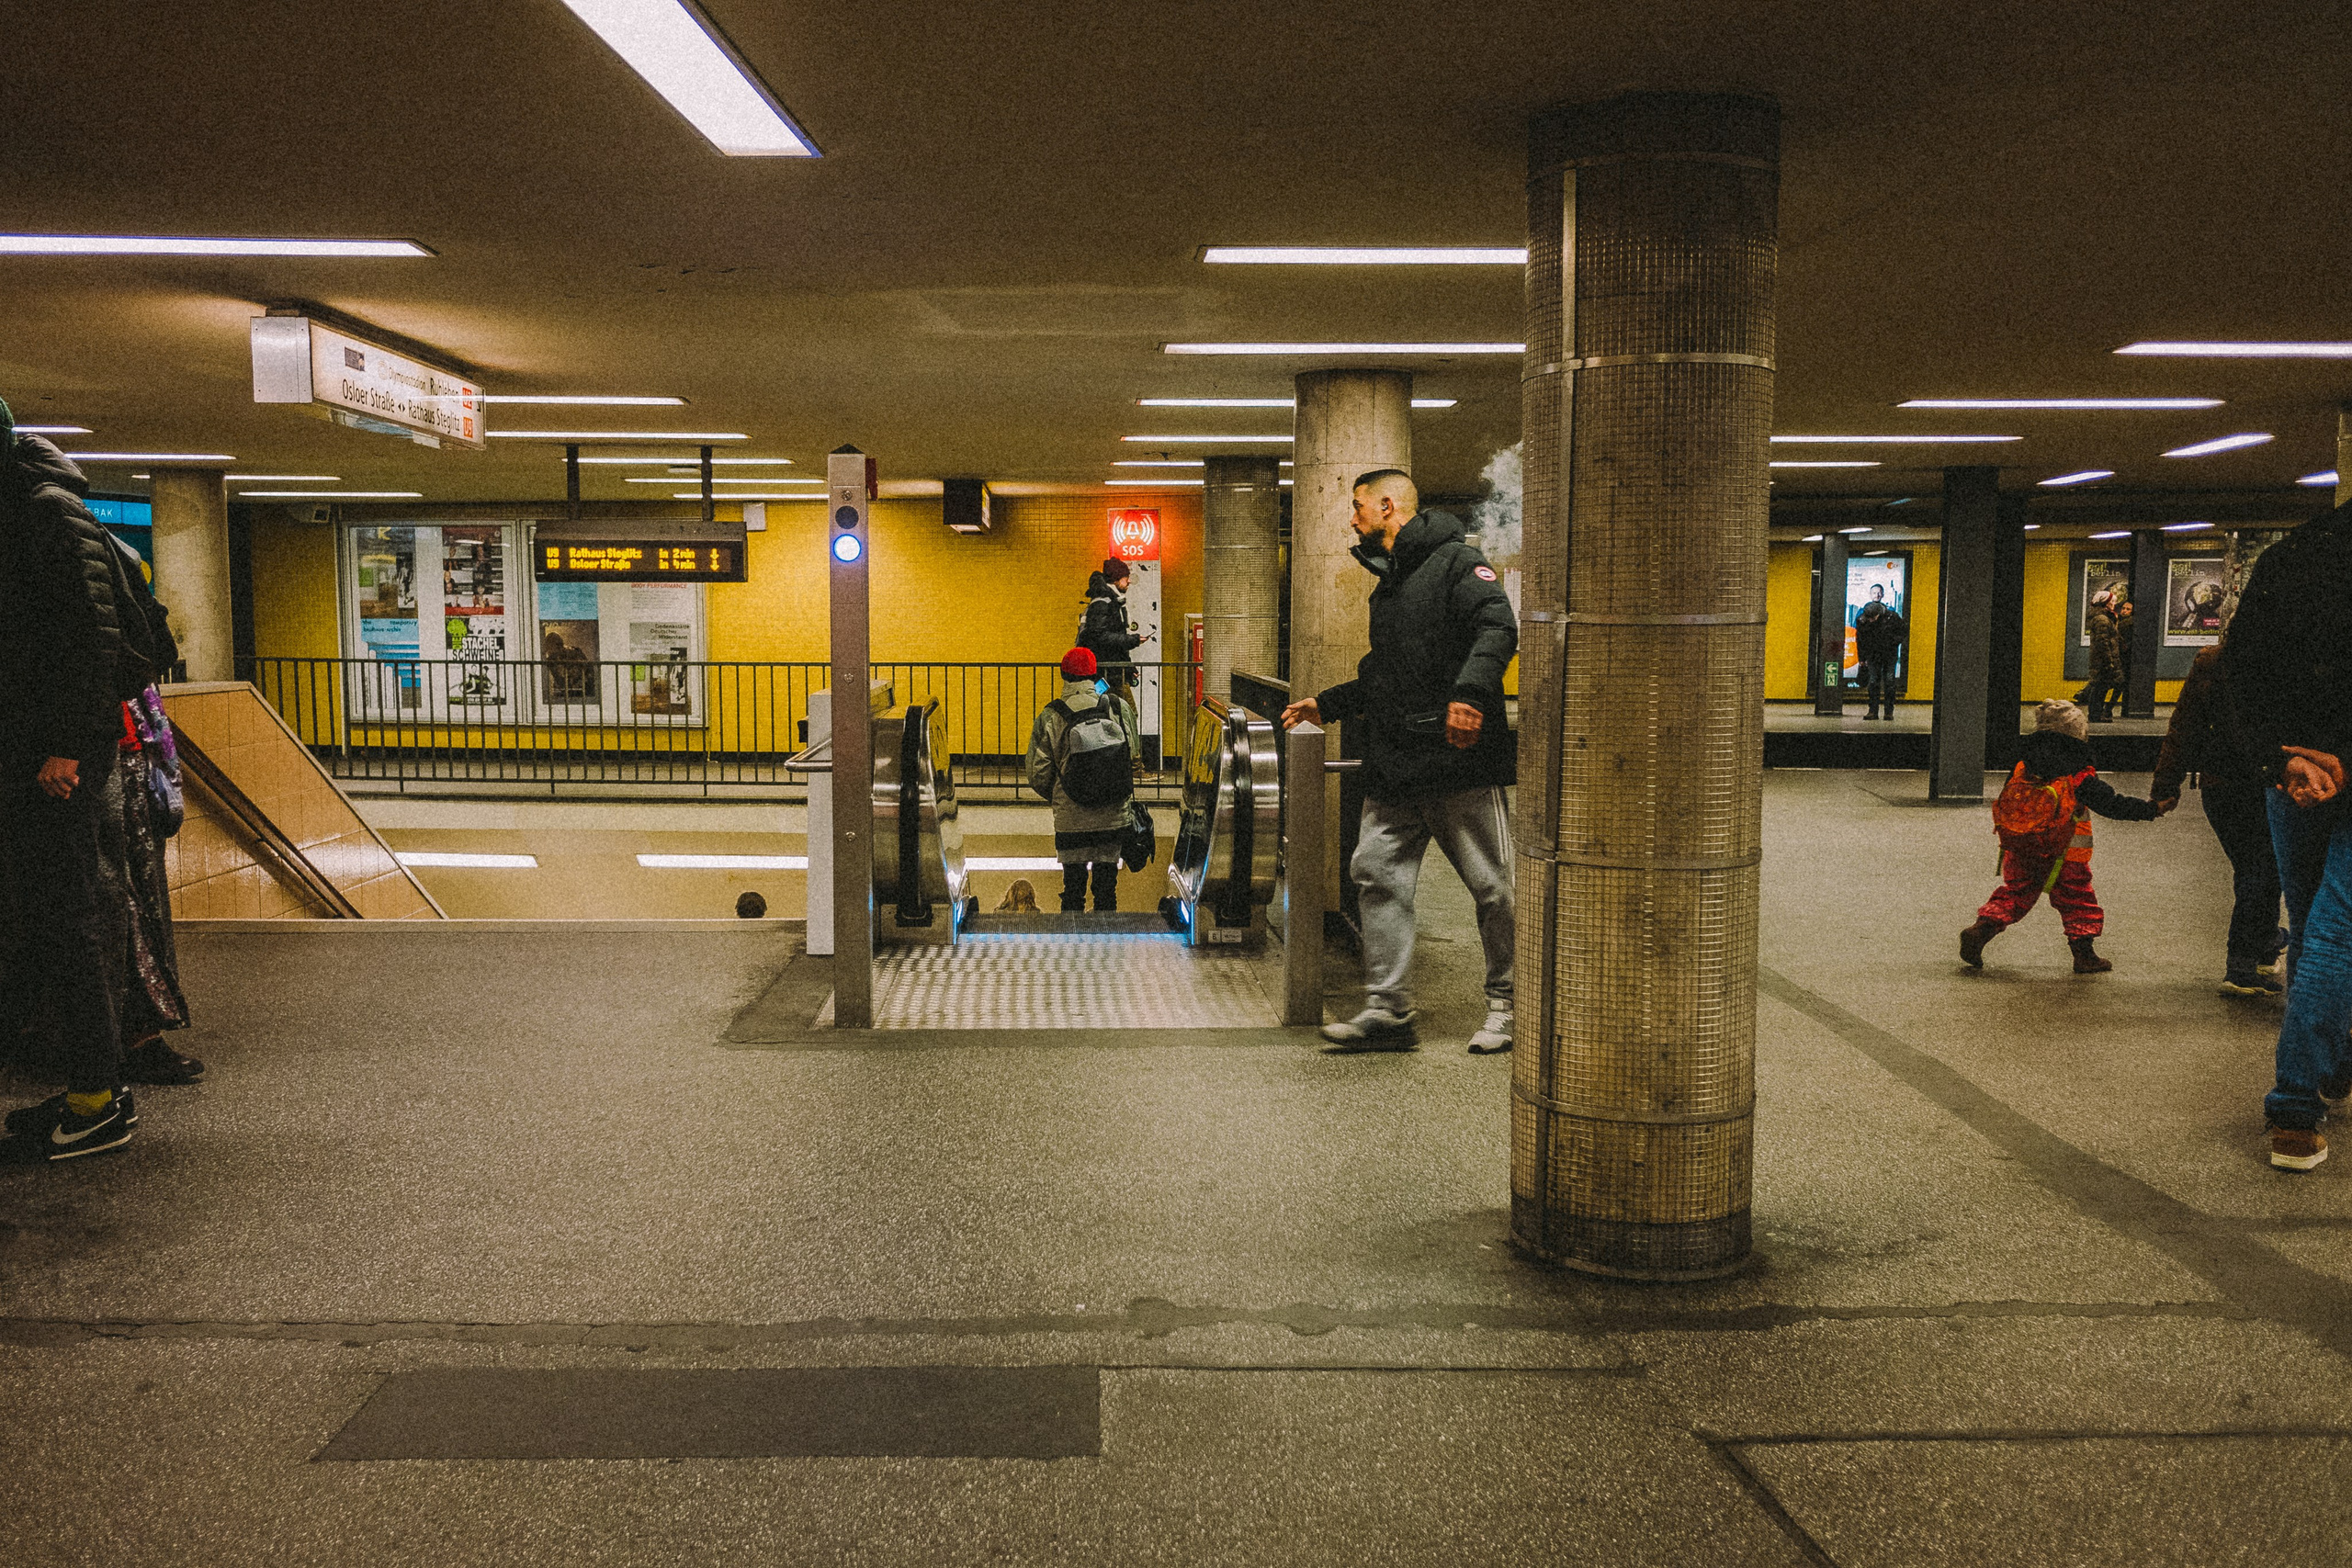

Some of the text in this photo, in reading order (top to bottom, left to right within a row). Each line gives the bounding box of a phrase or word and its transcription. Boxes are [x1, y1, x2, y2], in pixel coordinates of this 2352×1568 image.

[342, 378, 395, 413] Osloer Straße
[408, 399, 473, 437] Rathaus Steglitz U9
[89, 507, 113, 518] BAK
[547, 547, 560, 558] U9
[570, 547, 606, 558] Rathaus
[606, 547, 642, 559] Steglitz
[659, 547, 669, 558] in
[1122, 545, 1144, 556] SOS
[547, 558, 560, 569] U9
[570, 558, 600, 569] Osloer
[659, 558, 669, 570] in
[462, 637, 500, 649] STACHEL
[452, 649, 500, 660] SCHWEINE
